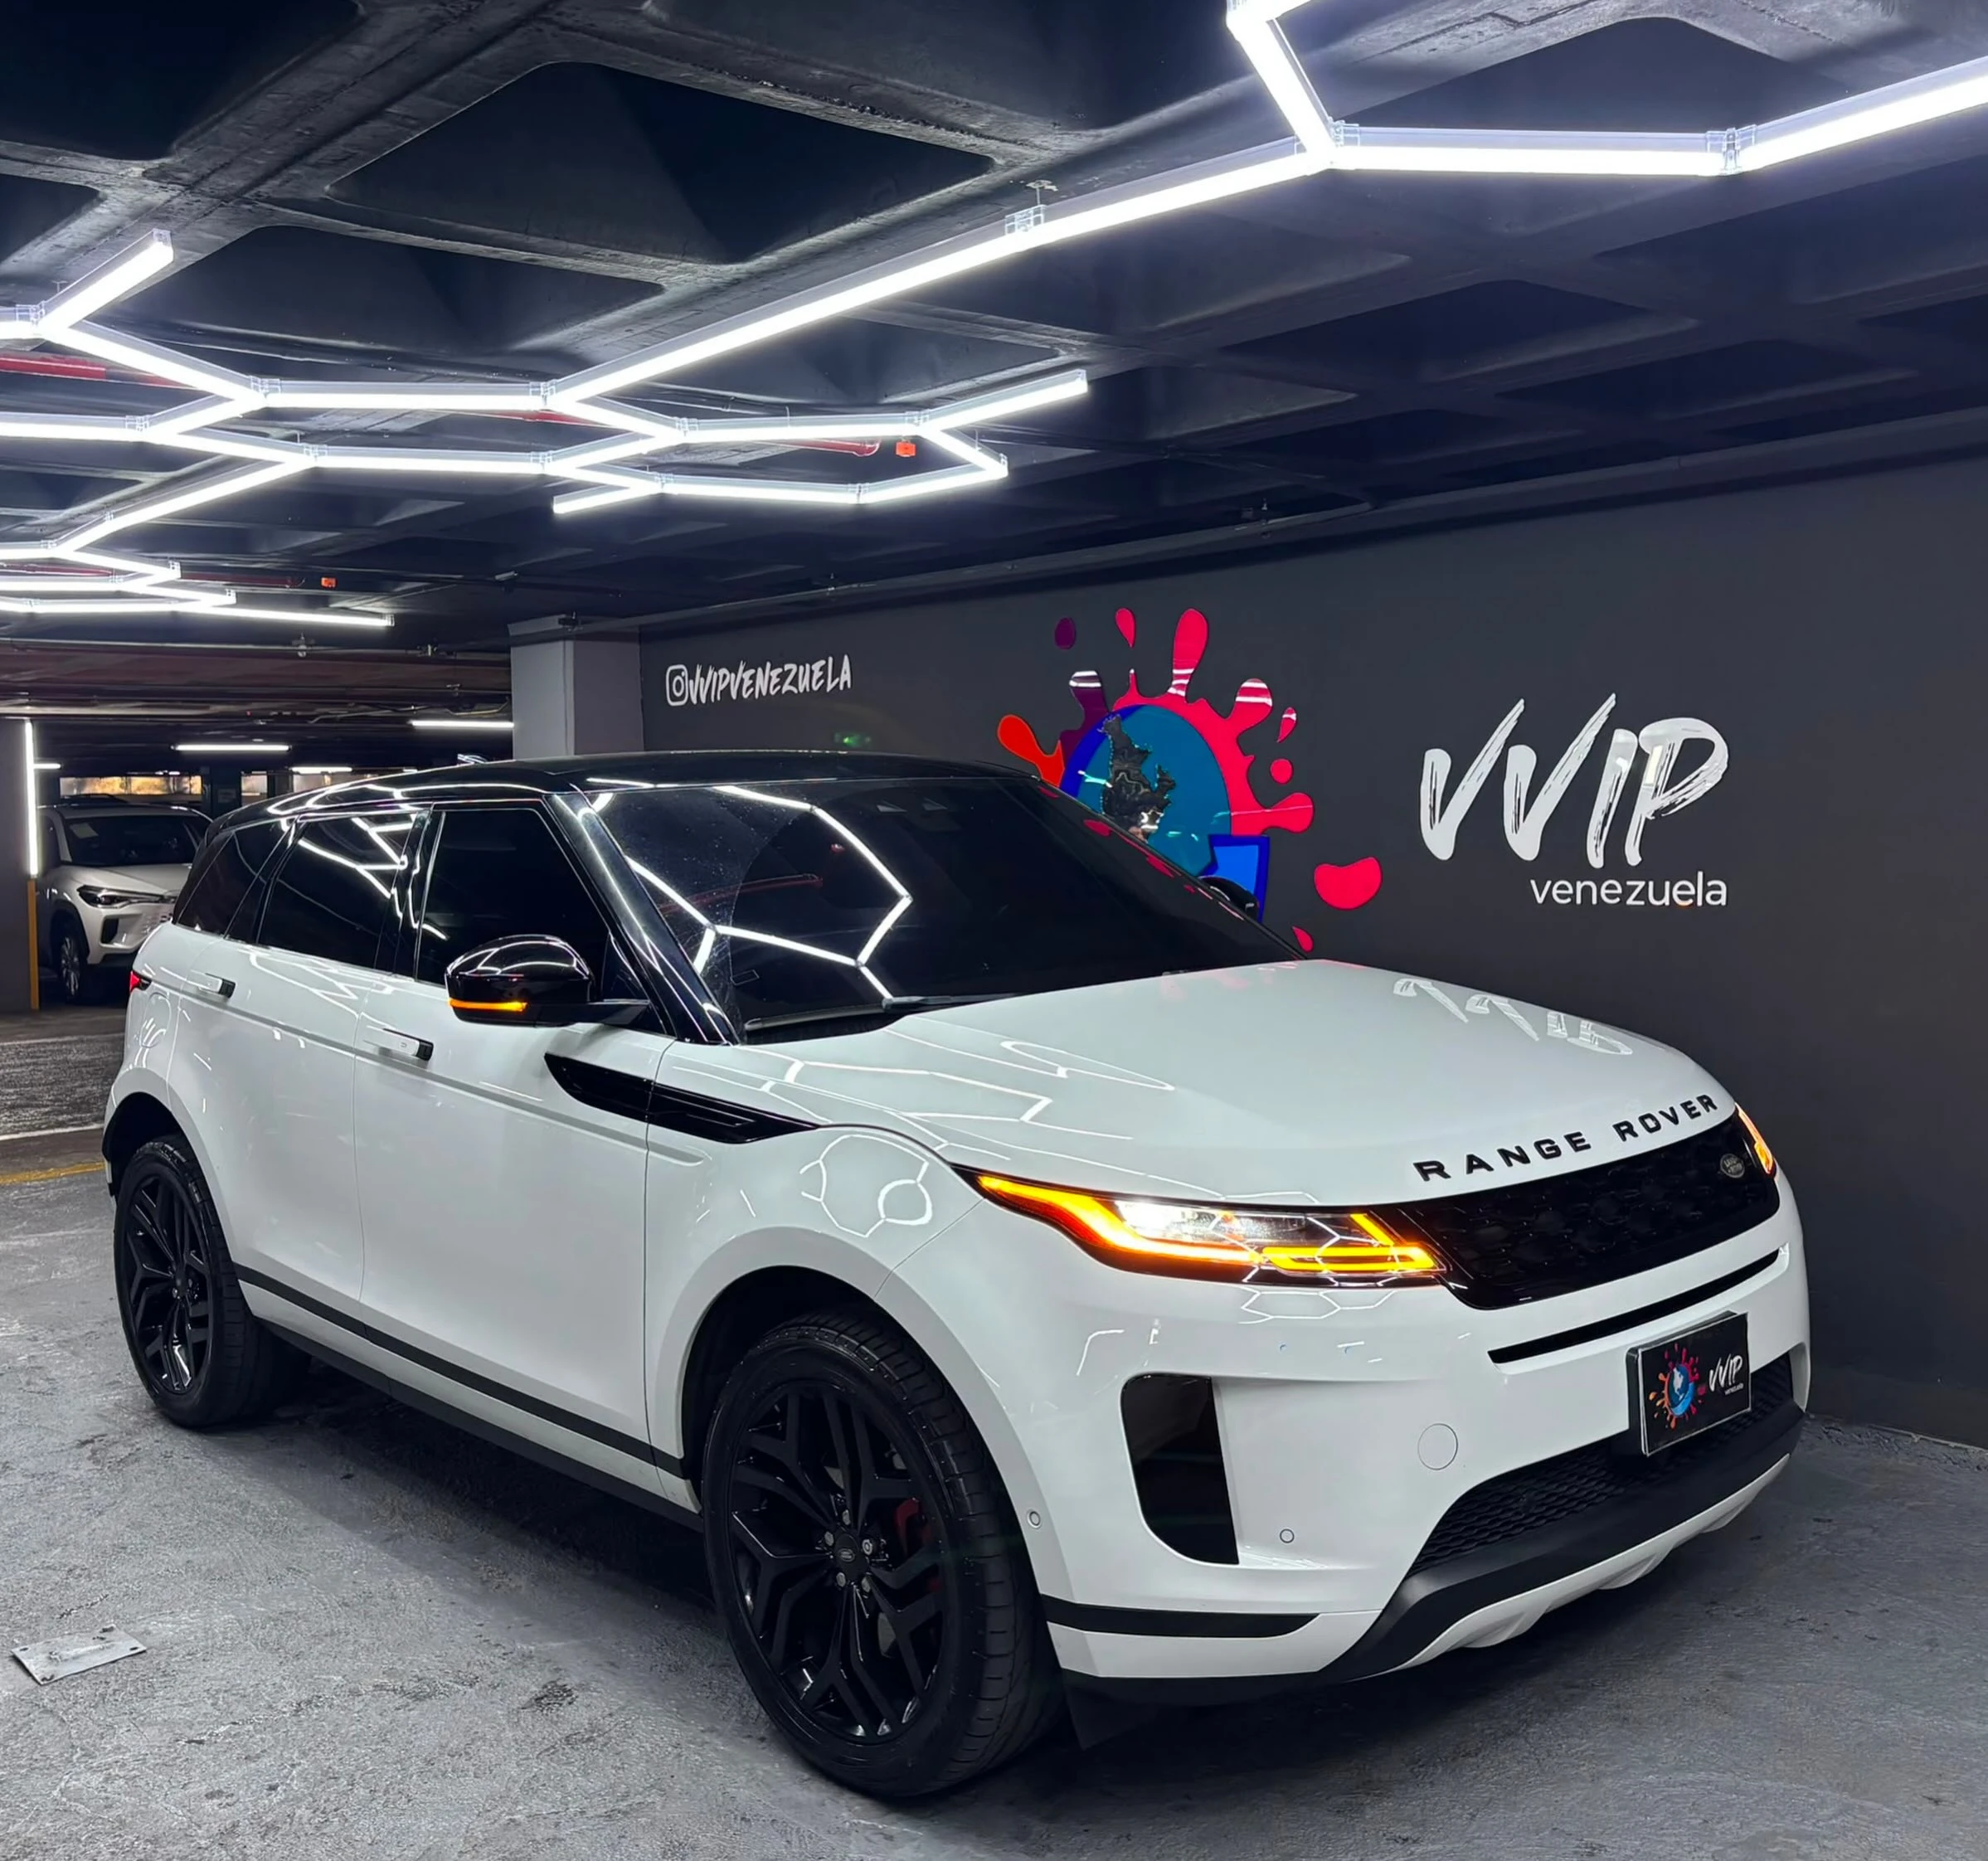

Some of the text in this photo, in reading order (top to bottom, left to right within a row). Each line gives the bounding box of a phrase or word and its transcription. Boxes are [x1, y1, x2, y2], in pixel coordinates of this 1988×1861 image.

[1530, 871, 1728, 907] venezuela
[1412, 1094, 1718, 1183] RANGE ROVER
